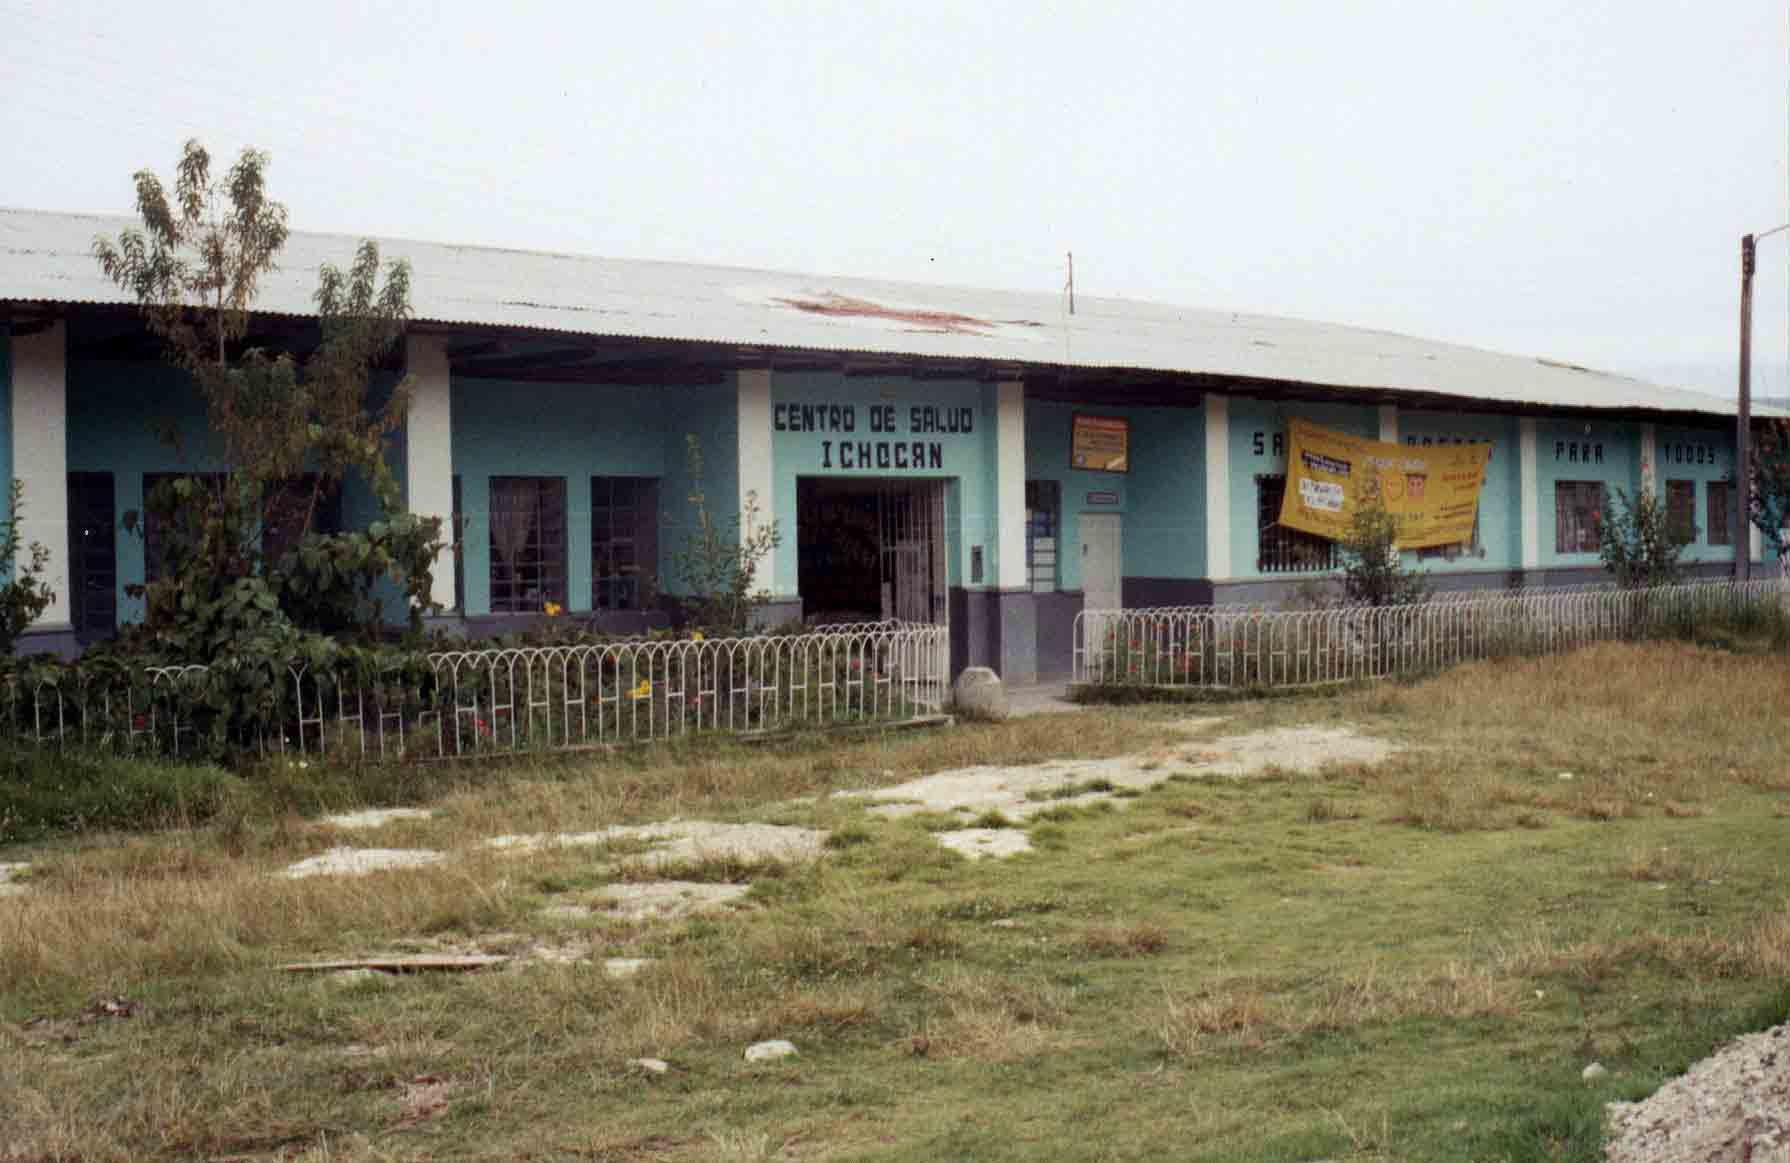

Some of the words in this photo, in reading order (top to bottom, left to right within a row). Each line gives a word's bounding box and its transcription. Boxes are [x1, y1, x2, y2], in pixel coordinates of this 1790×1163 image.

[774, 404, 855, 432] CENTRO
[870, 405, 896, 432] DE
[910, 407, 973, 433] SALUD
[822, 441, 943, 469] ICHOCAN
[1555, 441, 1603, 463] PARA
[1664, 443, 1715, 464] TODOS
